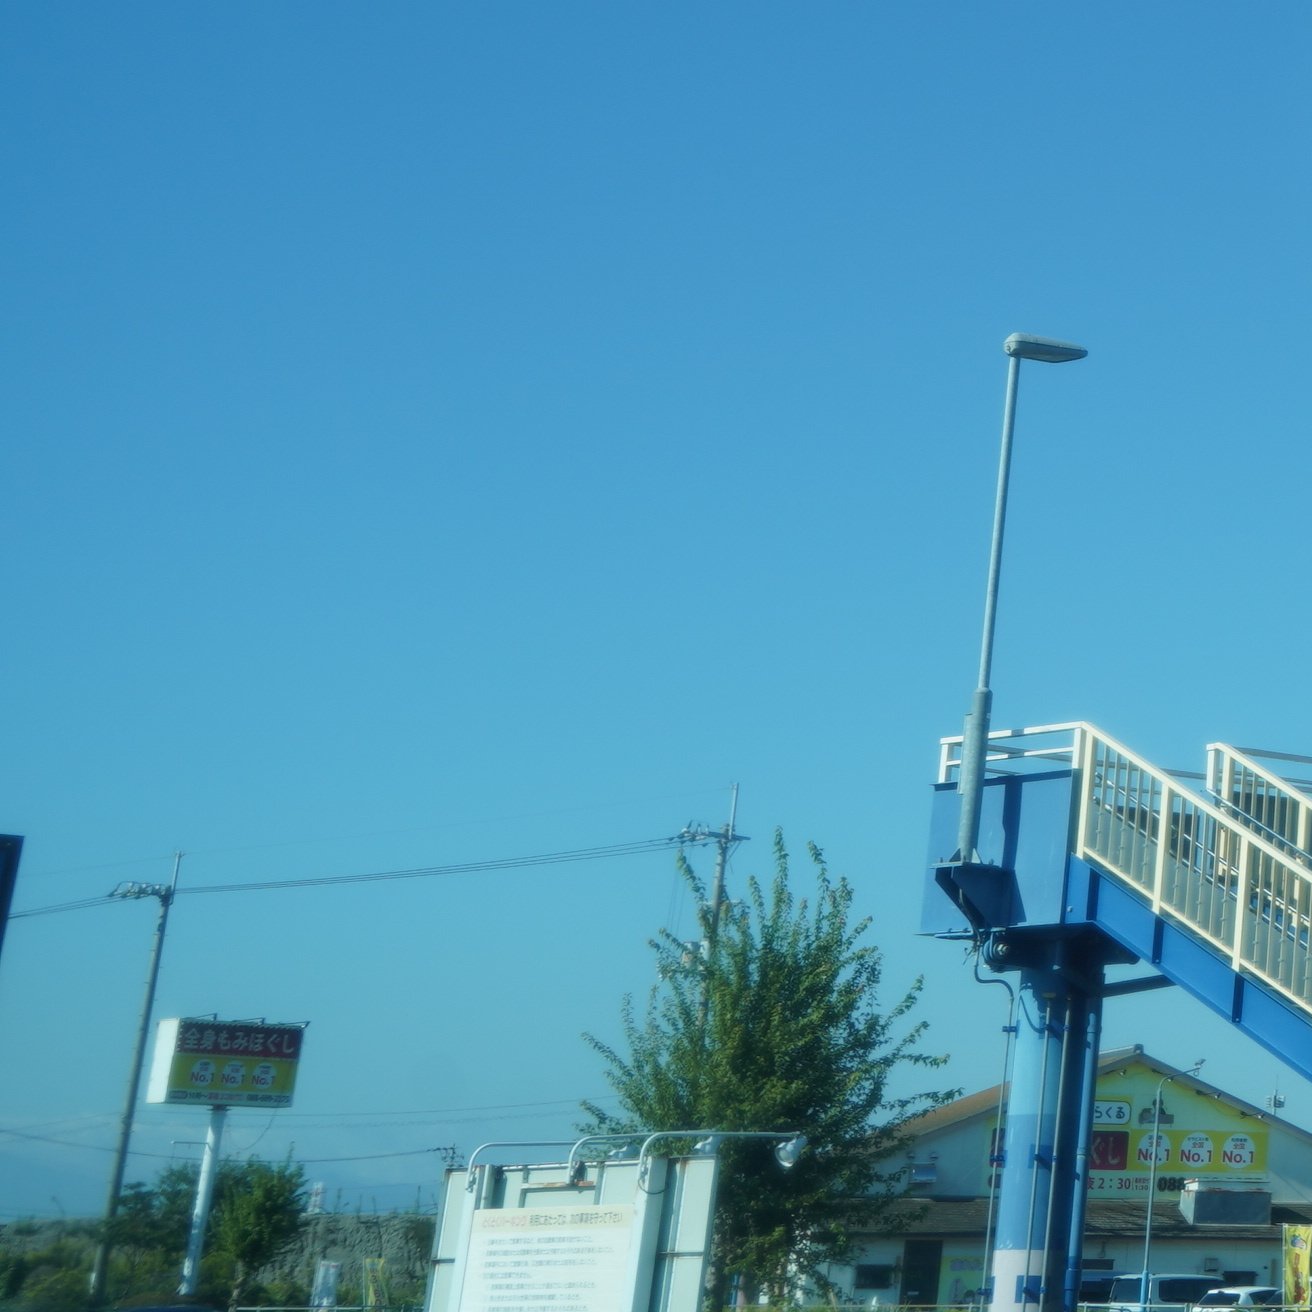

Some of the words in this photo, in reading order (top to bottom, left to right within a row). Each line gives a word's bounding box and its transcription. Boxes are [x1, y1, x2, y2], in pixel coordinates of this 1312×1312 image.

[184, 1028, 295, 1054] 全身もみほぐし
[1180, 1149, 1212, 1162] No.1
[1222, 1150, 1254, 1163] No.1
